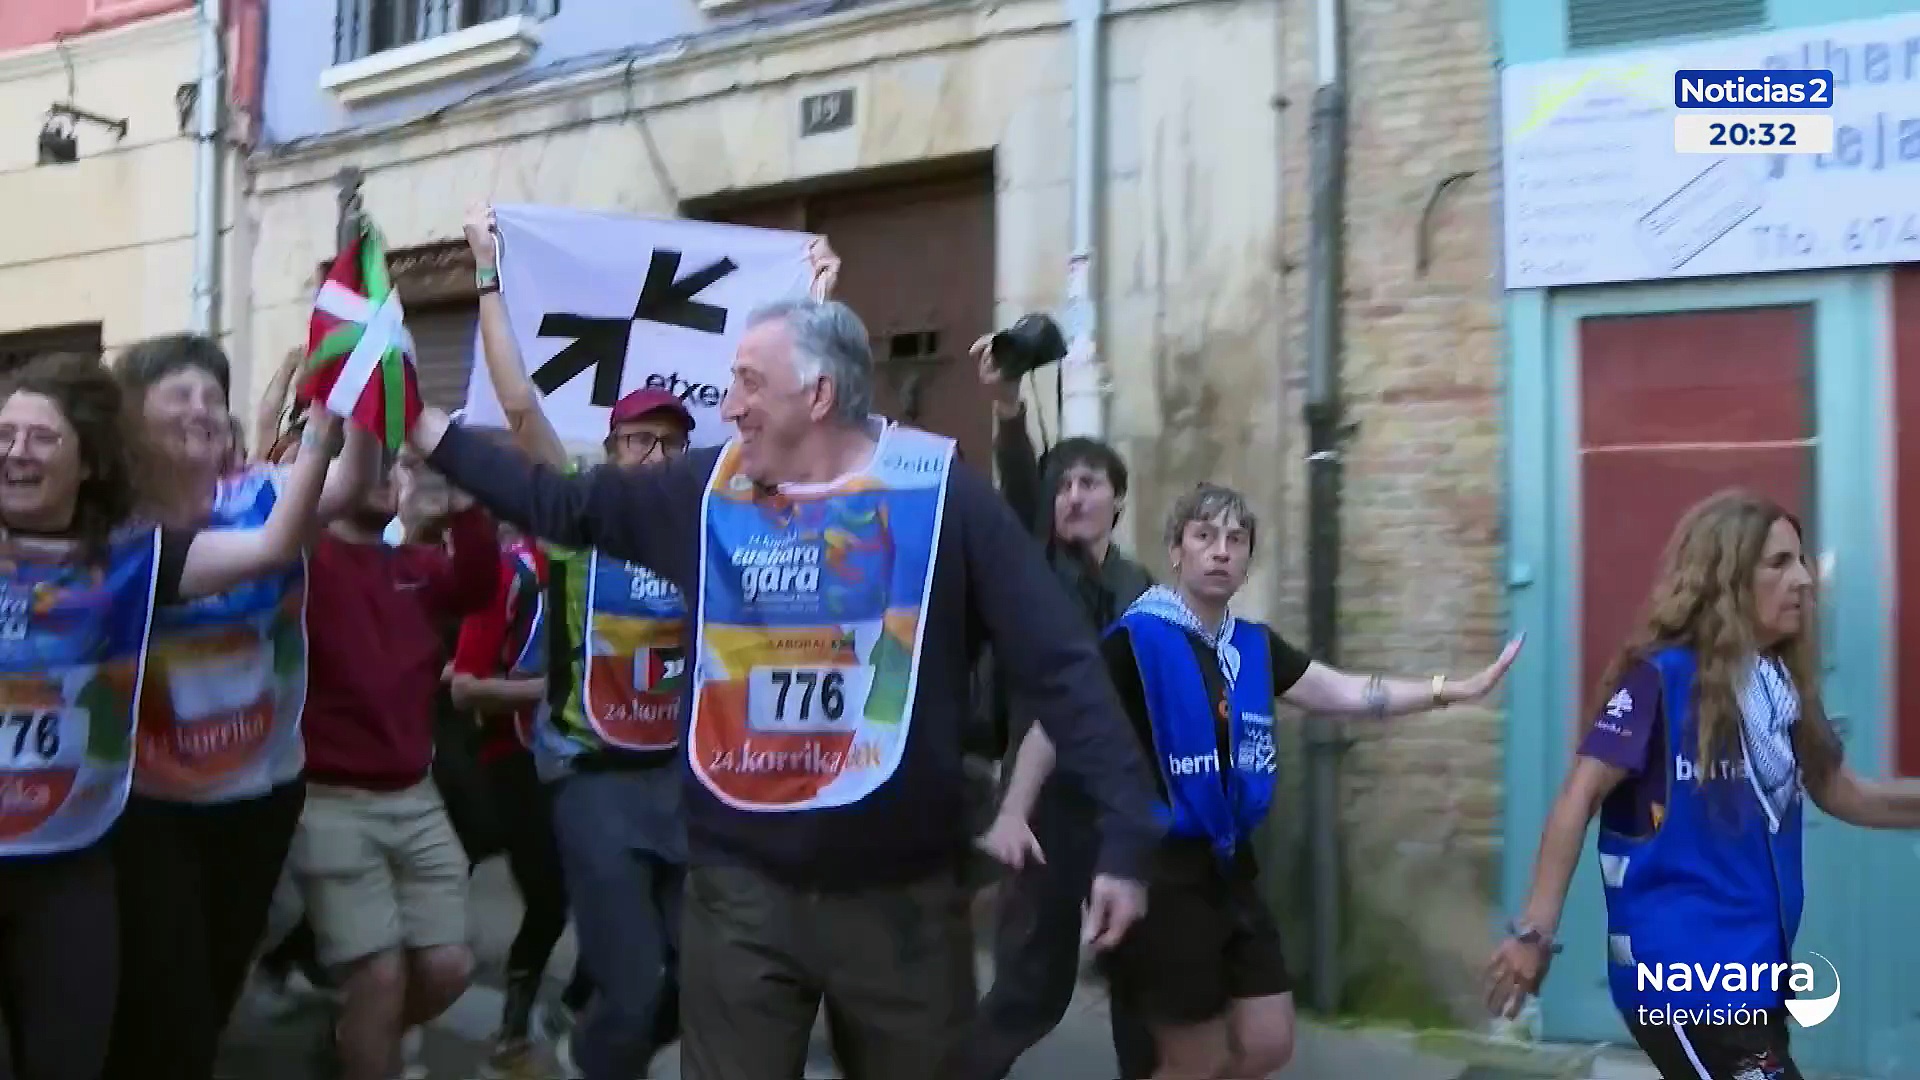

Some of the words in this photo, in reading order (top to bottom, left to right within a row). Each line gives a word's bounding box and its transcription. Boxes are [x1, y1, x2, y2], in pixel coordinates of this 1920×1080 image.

[645, 371, 728, 408] etxe
[741, 566, 820, 603] gara
[771, 671, 845, 722] 776
[0, 712, 58, 759] 76
[1168, 749, 1220, 776] berri
